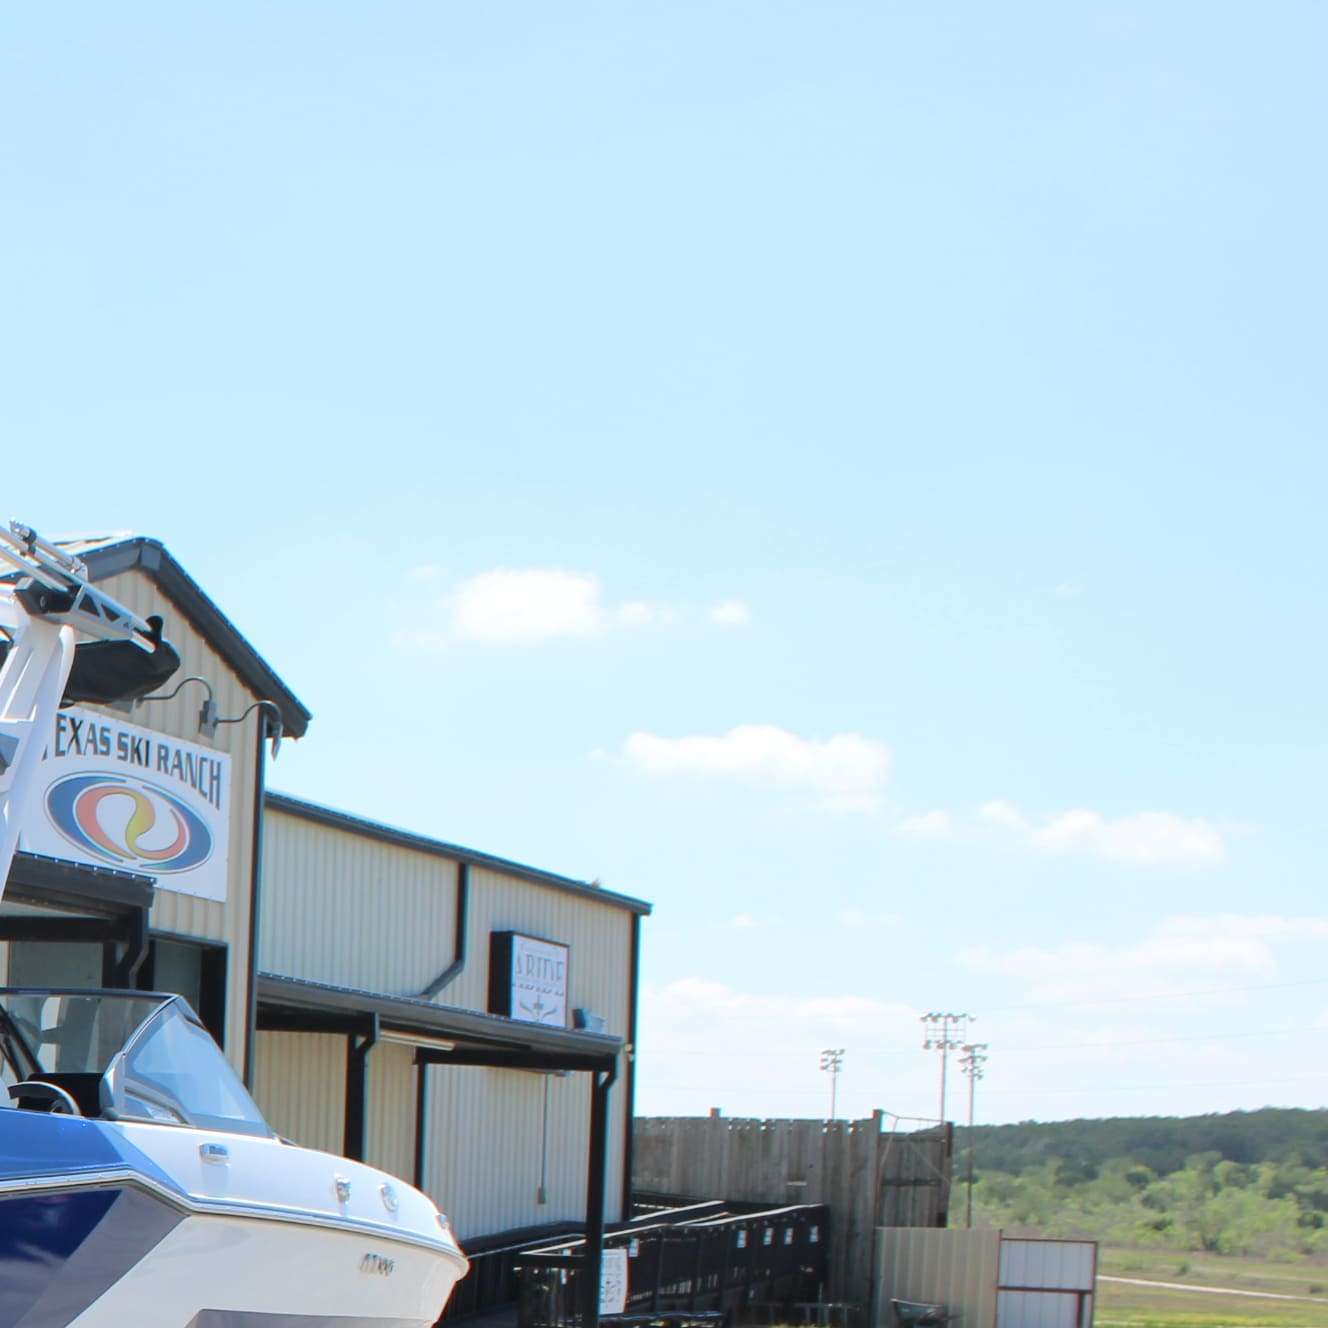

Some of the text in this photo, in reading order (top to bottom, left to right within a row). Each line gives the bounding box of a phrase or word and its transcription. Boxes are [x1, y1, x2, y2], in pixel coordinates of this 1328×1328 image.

[42, 712, 222, 810] EXAS SKI RANCH
